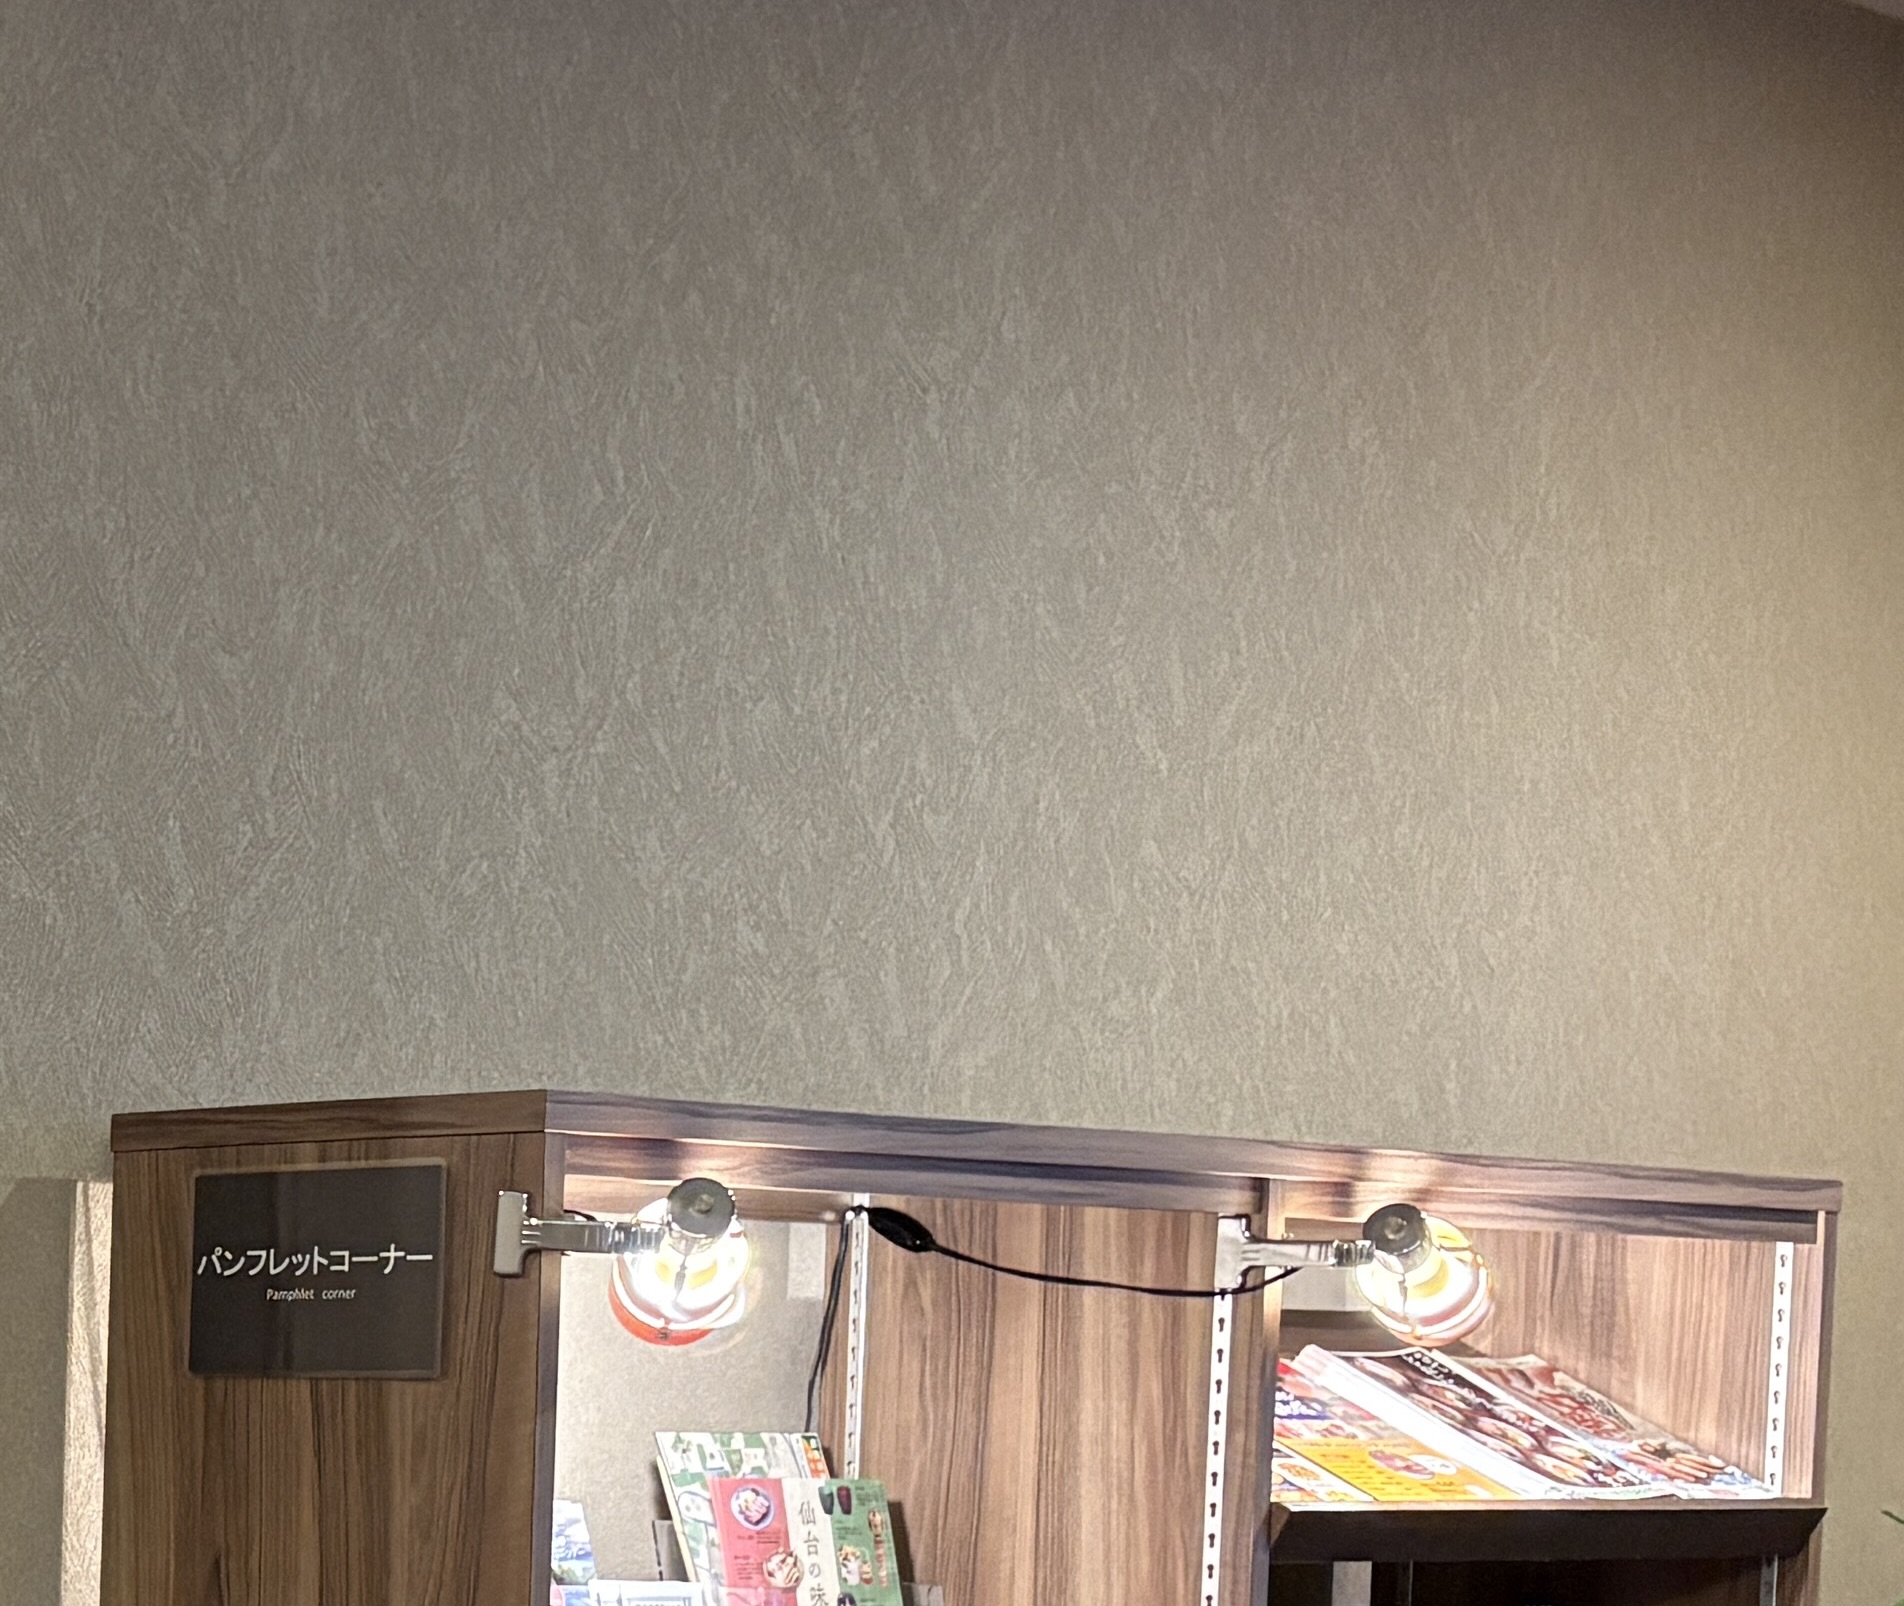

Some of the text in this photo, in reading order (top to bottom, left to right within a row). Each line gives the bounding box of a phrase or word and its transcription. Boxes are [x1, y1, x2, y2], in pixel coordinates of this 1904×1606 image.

[197, 1243, 434, 1276] パンフレットコーナー
[265, 1288, 356, 1302] Pamphlet corner
